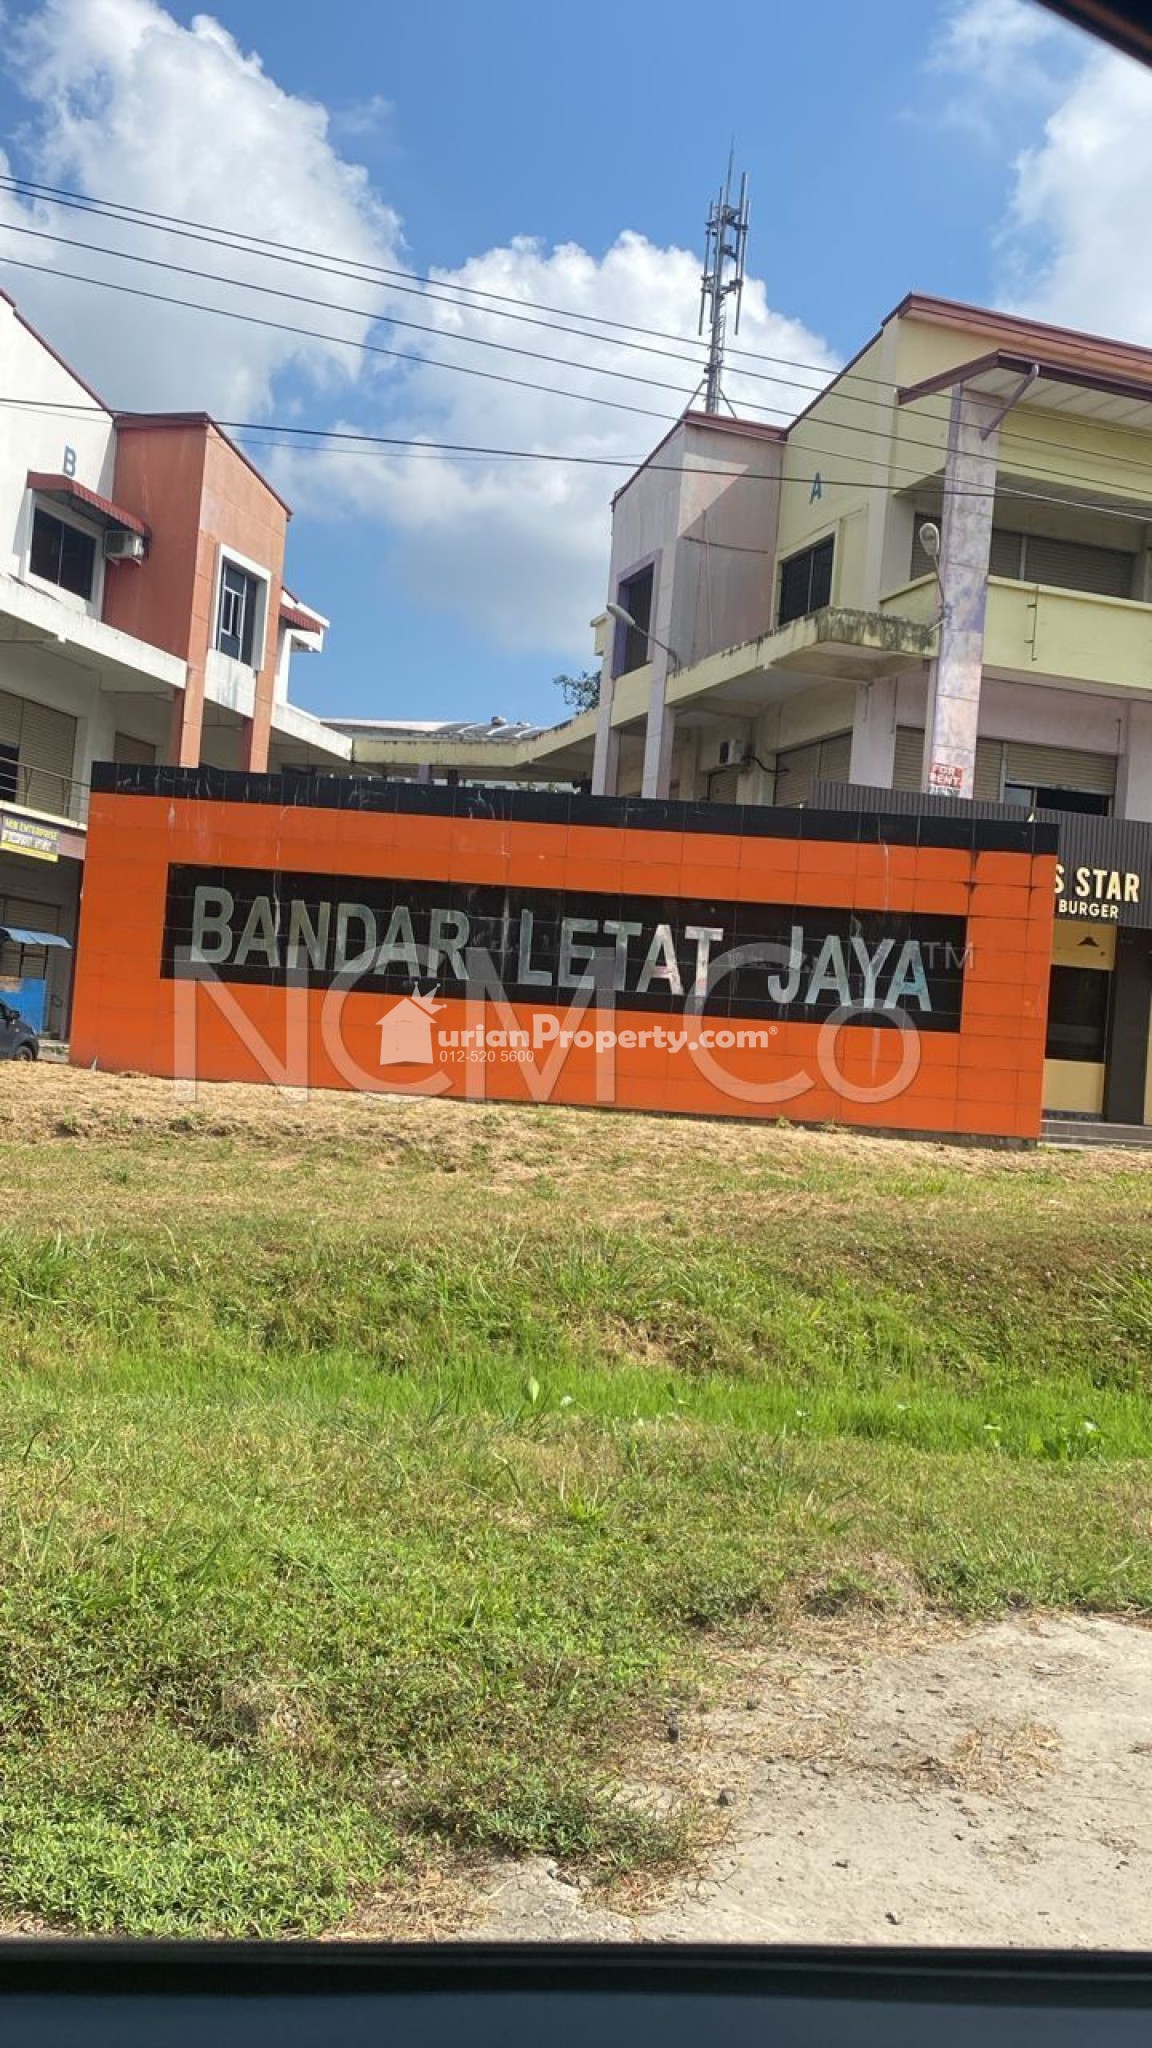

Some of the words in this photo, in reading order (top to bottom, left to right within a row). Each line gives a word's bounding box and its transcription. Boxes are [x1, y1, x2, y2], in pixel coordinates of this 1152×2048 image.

[63, 445, 77, 477] B
[809, 471, 822, 504] A
[929, 772, 961, 787] RENT
[933, 765, 956, 777] FOR
[1075, 866, 1140, 903] STAR
[1058, 899, 1119, 919] BURGER
[190, 885, 470, 980] BANDAR
[517, 908, 724, 999] LETAT
[767, 925, 932, 1012] JAYA
